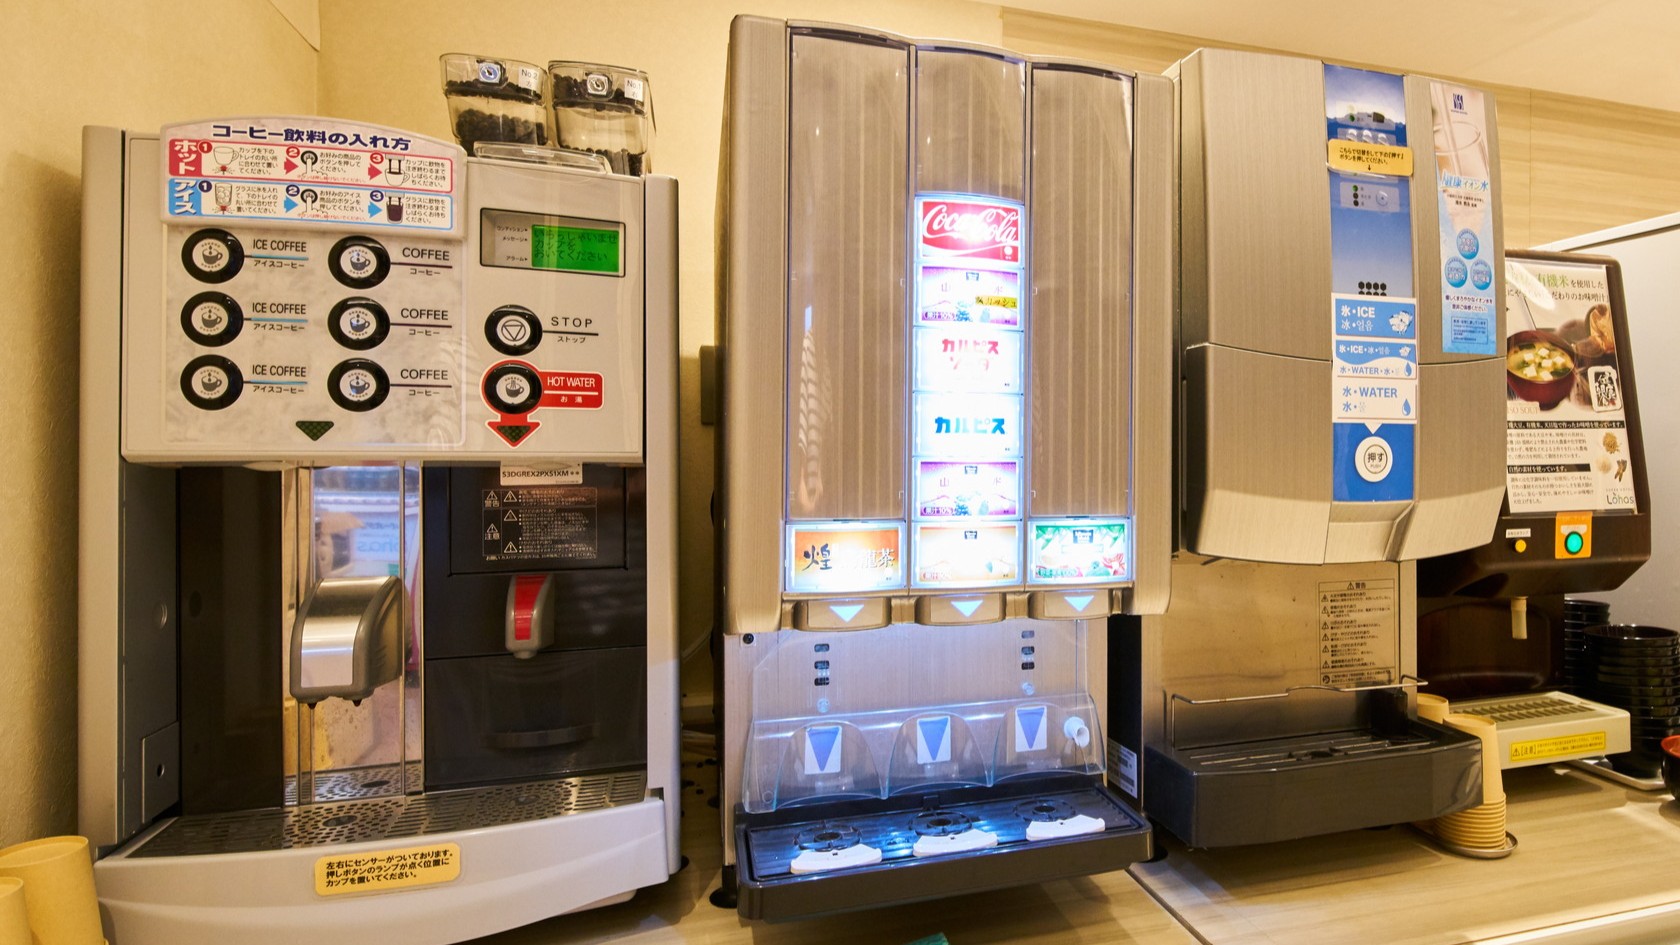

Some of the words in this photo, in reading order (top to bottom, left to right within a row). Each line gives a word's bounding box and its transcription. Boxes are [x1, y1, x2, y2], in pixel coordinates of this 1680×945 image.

[213, 125, 412, 151] コーヒー飲料の入れ方
[174, 140, 197, 175] ホット
[319, 152, 361, 160] お好みの商品の
[319, 159, 361, 167] ボタンを押して
[405, 159, 445, 167] カップに飲物を
[405, 166, 446, 174] 注ぎ終わるまで
[411, 173, 446, 181] しばらくお待
[174, 180, 197, 215] アイス
[319, 190, 361, 198] お好みのアイス
[319, 197, 361, 205] 商品のボタンを
[405, 196, 446, 205] グラスに飲物を
[236, 206, 277, 214] 置いてください。
[319, 204, 364, 212] 押してください。
[405, 204, 446, 212] 注ぎ終わるまで
[405, 210, 446, 218] しばらくお待ち
[922, 204, 1019, 243] CocCola
[534, 230, 617, 244] いらっしゃいませ
[252, 239, 268, 250] ICE
[270, 240, 307, 252] COFFEE
[402, 247, 450, 261] COFFEE
[534, 250, 608, 262] おいてください
[254, 259, 305, 269] アイスコーヒー
[410, 268, 441, 276] コーヒー
[252, 302, 267, 313] ICE
[270, 303, 306, 315] COFFEE
[400, 308, 449, 320] COFFEE
[551, 316, 593, 328] STOP
[253, 323, 305, 332] アイスコーヒー
[409, 328, 440, 336] コーヒー
[557, 336, 586, 344] ストップ
[252, 364, 267, 376] ICE
[270, 365, 307, 377] COFFEE
[400, 368, 448, 380] COFFEE
[547, 376, 565, 387] HOT
[567, 377, 595, 388] WATER
[253, 385, 304, 394] アイスコーヒー
[409, 389, 440, 397] コーヒー
[935, 416, 1006, 435] カルピス
[1367, 452, 1384, 463] 押す
[326, 849, 453, 870] 左右にセンサーがついております。
[326, 858, 450, 879] 押しボタンのランプが点く位置に
[326, 871, 417, 888] カップを置いてください。
